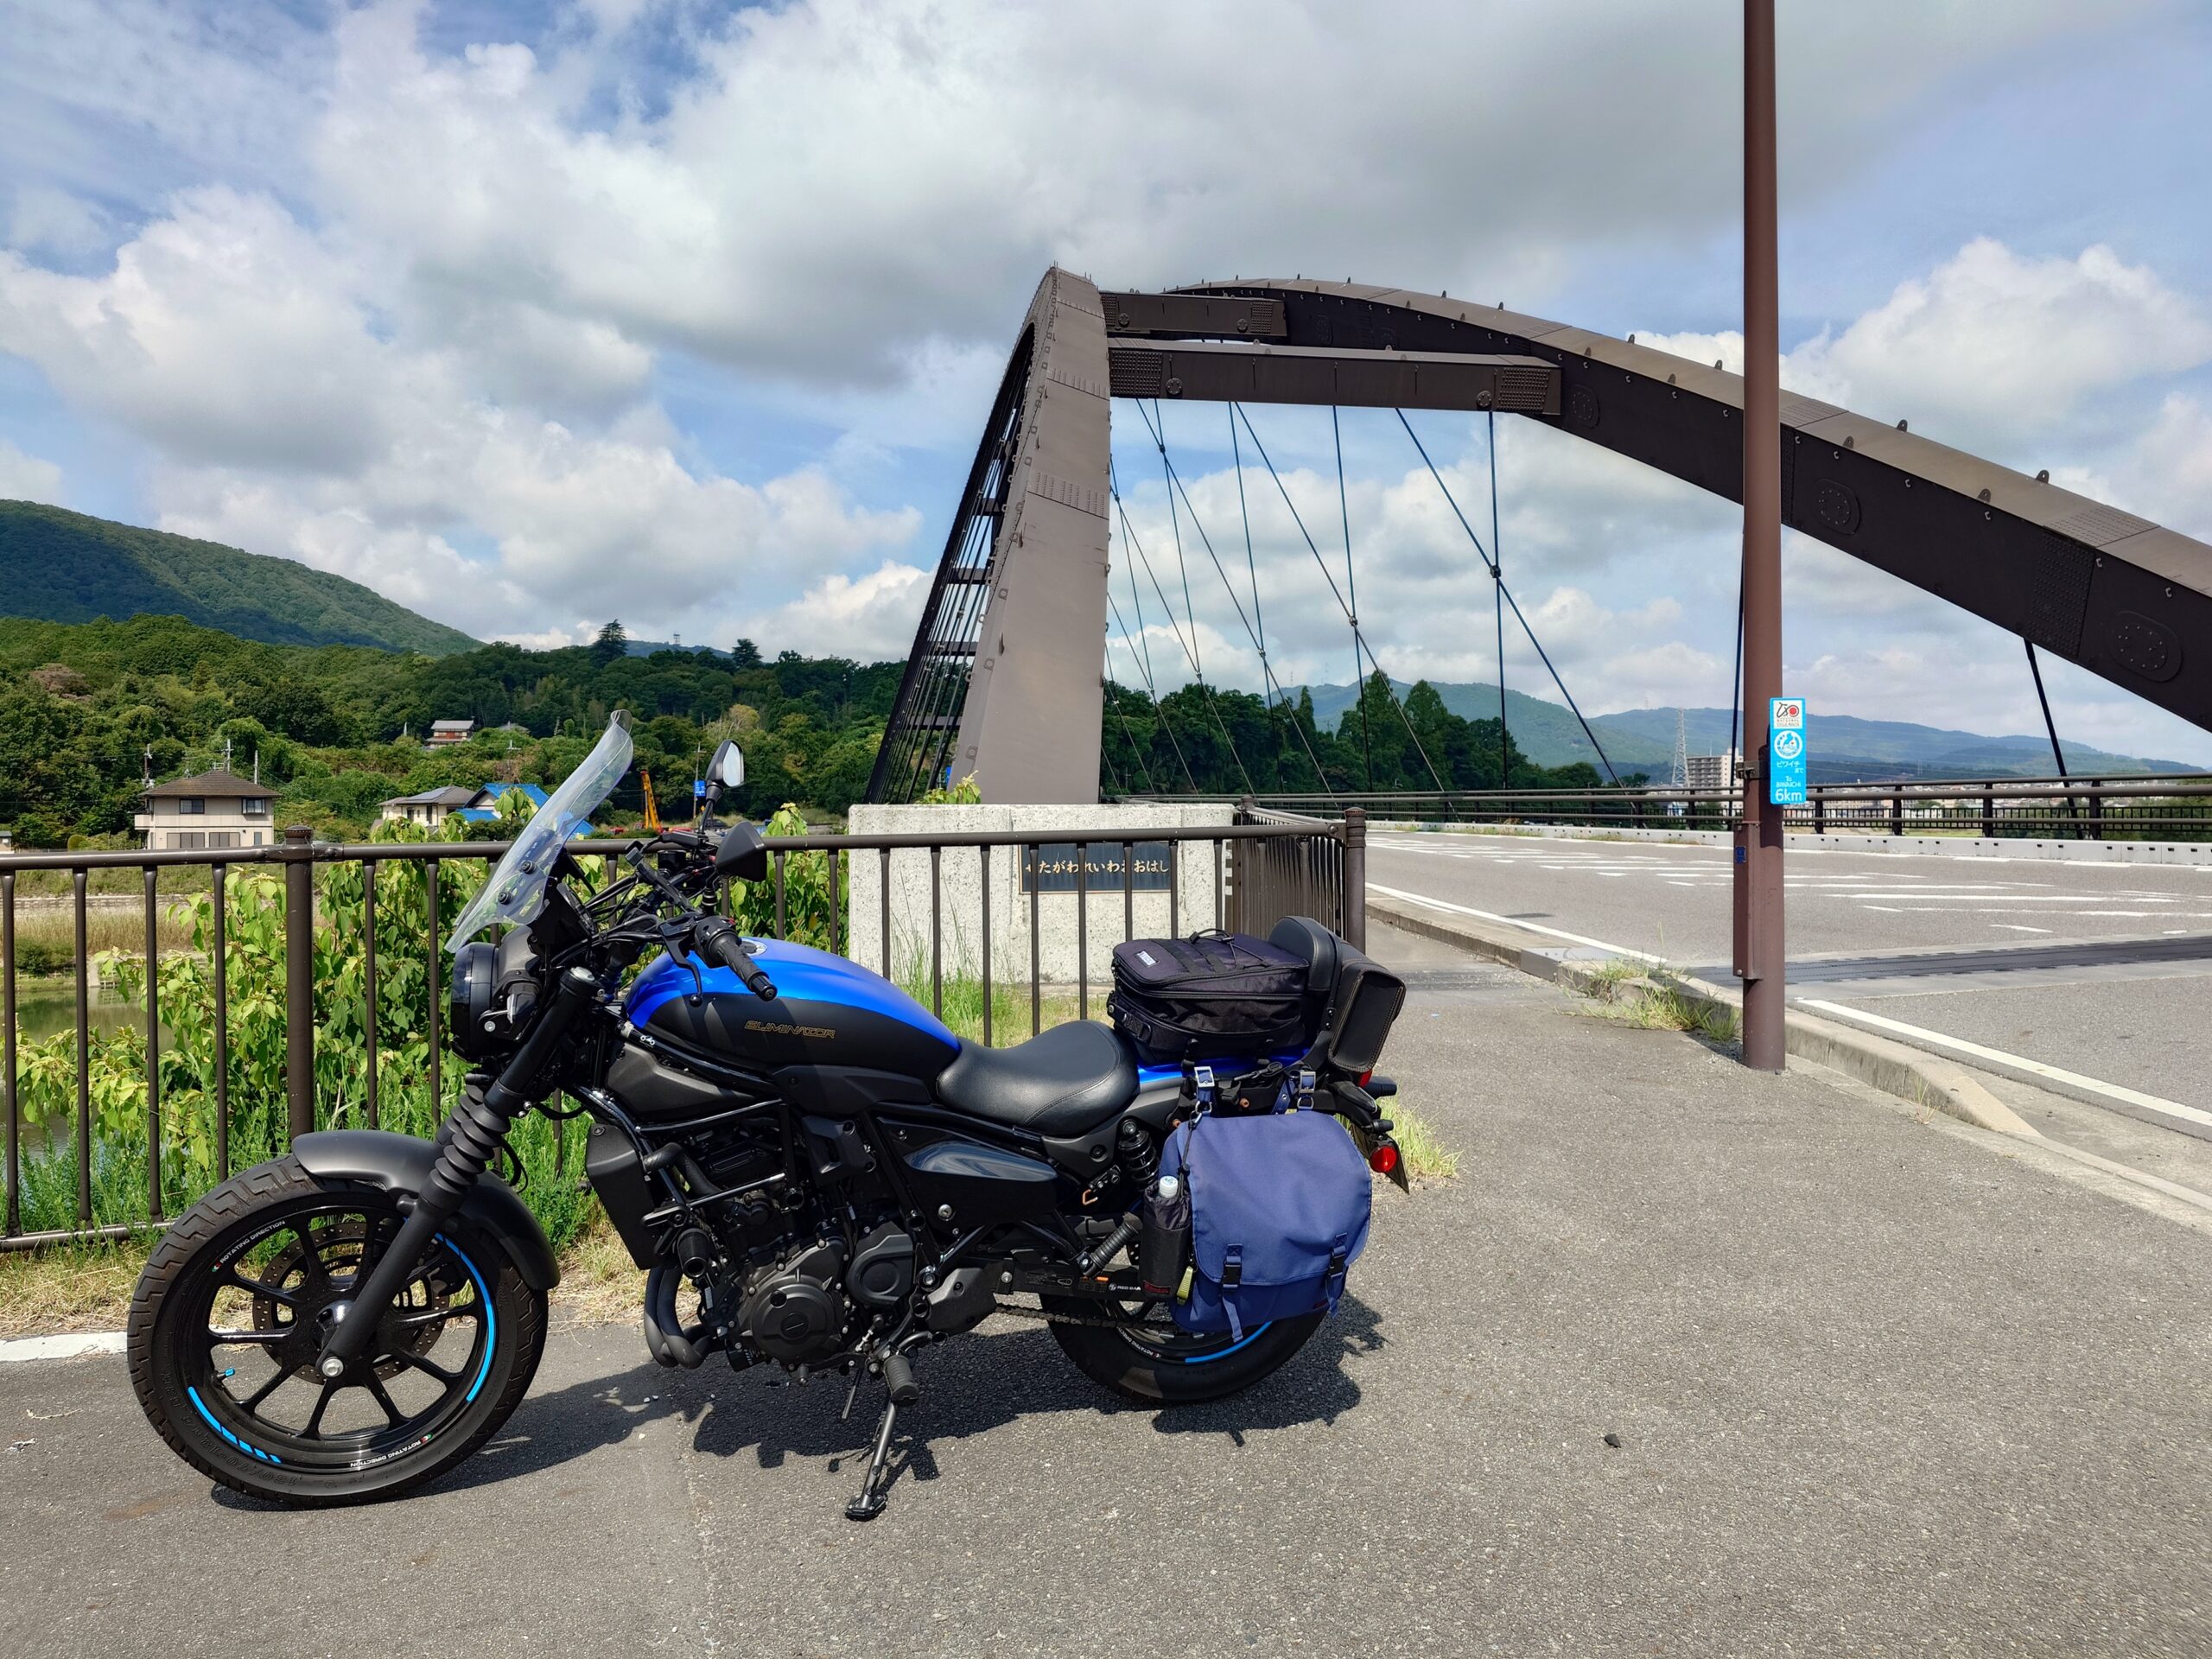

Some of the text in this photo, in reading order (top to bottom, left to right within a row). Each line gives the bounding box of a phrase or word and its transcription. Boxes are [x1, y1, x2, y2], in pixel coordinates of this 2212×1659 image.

[1776, 788, 1802, 802] 6km
[744, 1020, 836, 1039] ELIMINATOR
[219, 1220, 286, 1264] ROTATING DIRECTION
[1116, 1326, 1154, 1356] ROTATING DIRECT
[350, 1440, 421, 1468] ROTATING DIRECTION
